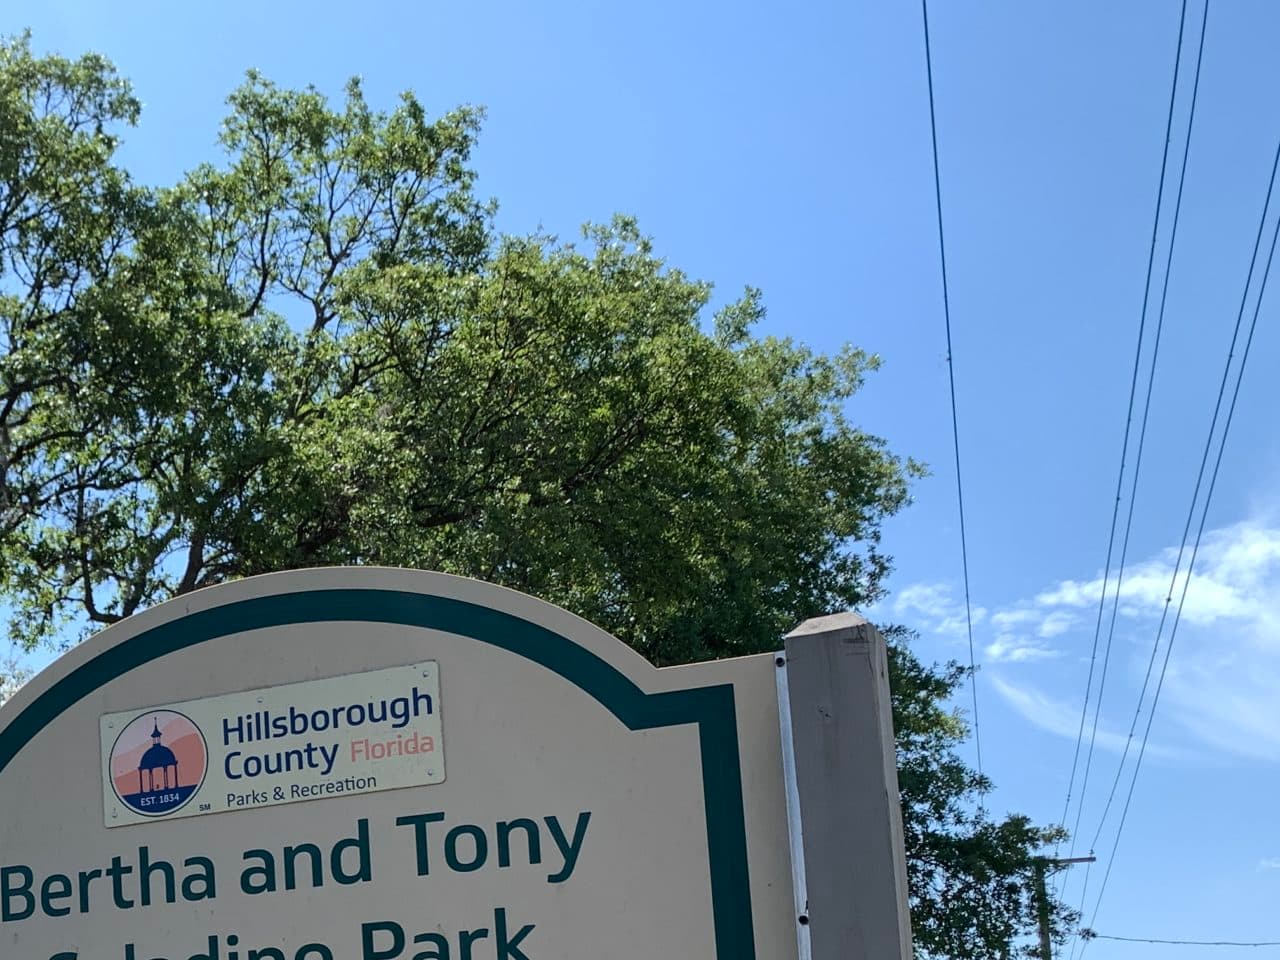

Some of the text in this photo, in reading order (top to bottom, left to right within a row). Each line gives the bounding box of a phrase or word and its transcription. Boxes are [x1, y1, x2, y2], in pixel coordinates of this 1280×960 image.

[222, 687, 433, 746] Hillsborough
[224, 732, 435, 780] County Florida
[226, 775, 377, 807] Parks & Recreation
[0, 811, 592, 922] Bertha and Tony
